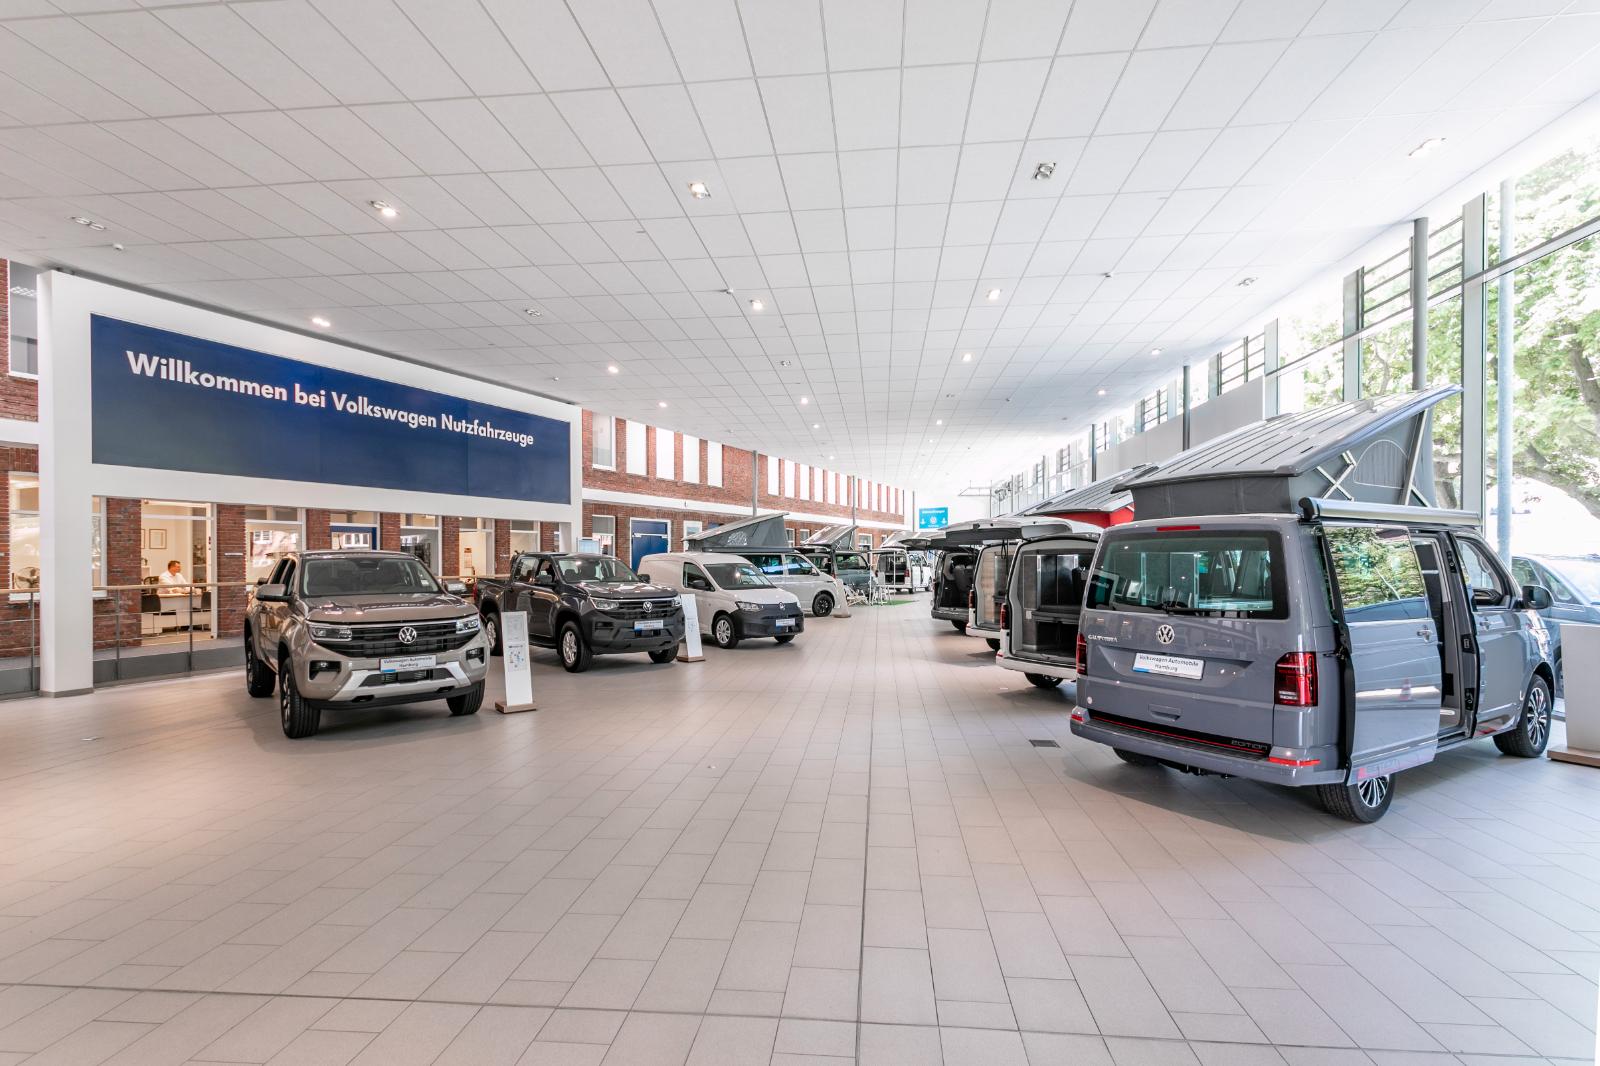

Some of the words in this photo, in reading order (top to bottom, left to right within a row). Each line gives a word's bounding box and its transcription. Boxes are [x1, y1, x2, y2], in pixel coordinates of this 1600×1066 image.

[126, 350, 288, 402] Willkommen
[294, 383, 326, 409] bei
[331, 391, 437, 429] Volkswagen
[441, 413, 535, 448] Nutzfahrzeuge
[399, 626, 417, 644] VW
[1157, 624, 1175, 645] VW
